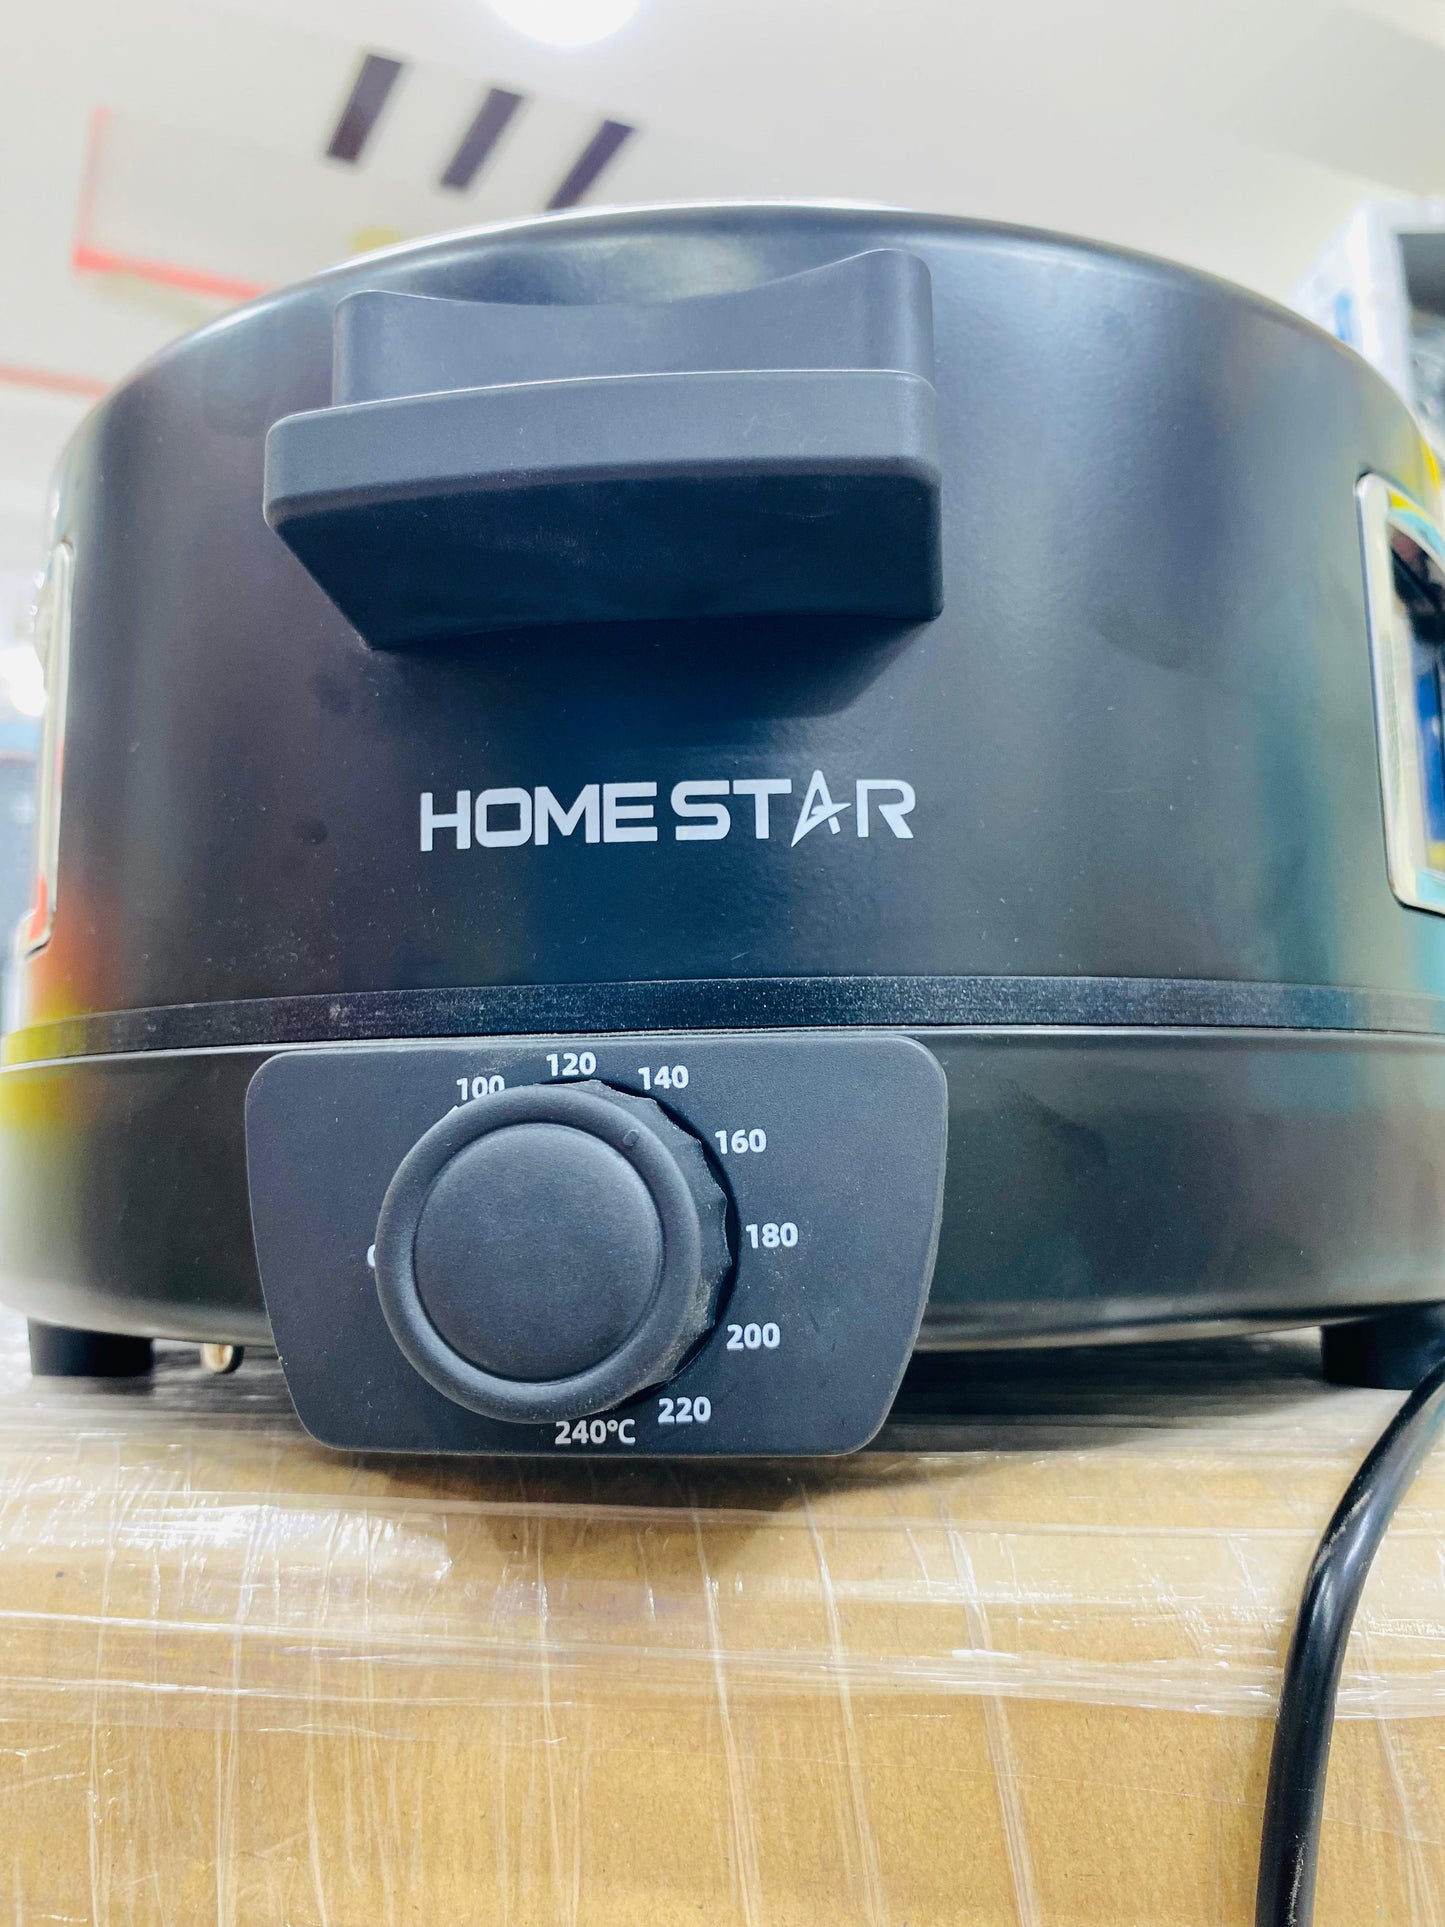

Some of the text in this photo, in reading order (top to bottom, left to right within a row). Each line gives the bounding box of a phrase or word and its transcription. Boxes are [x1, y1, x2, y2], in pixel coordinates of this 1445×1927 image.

[545, 1052, 596, 1077] 120
[637, 1065, 689, 1090] 140
[456, 1075, 506, 1101] 100
[714, 1128, 767, 1155] 160
[745, 1222, 799, 1249] 180
[726, 1322, 781, 1350] 200
[657, 1396, 712, 1424] 220
[554, 1418, 636, 1445] 240°C
